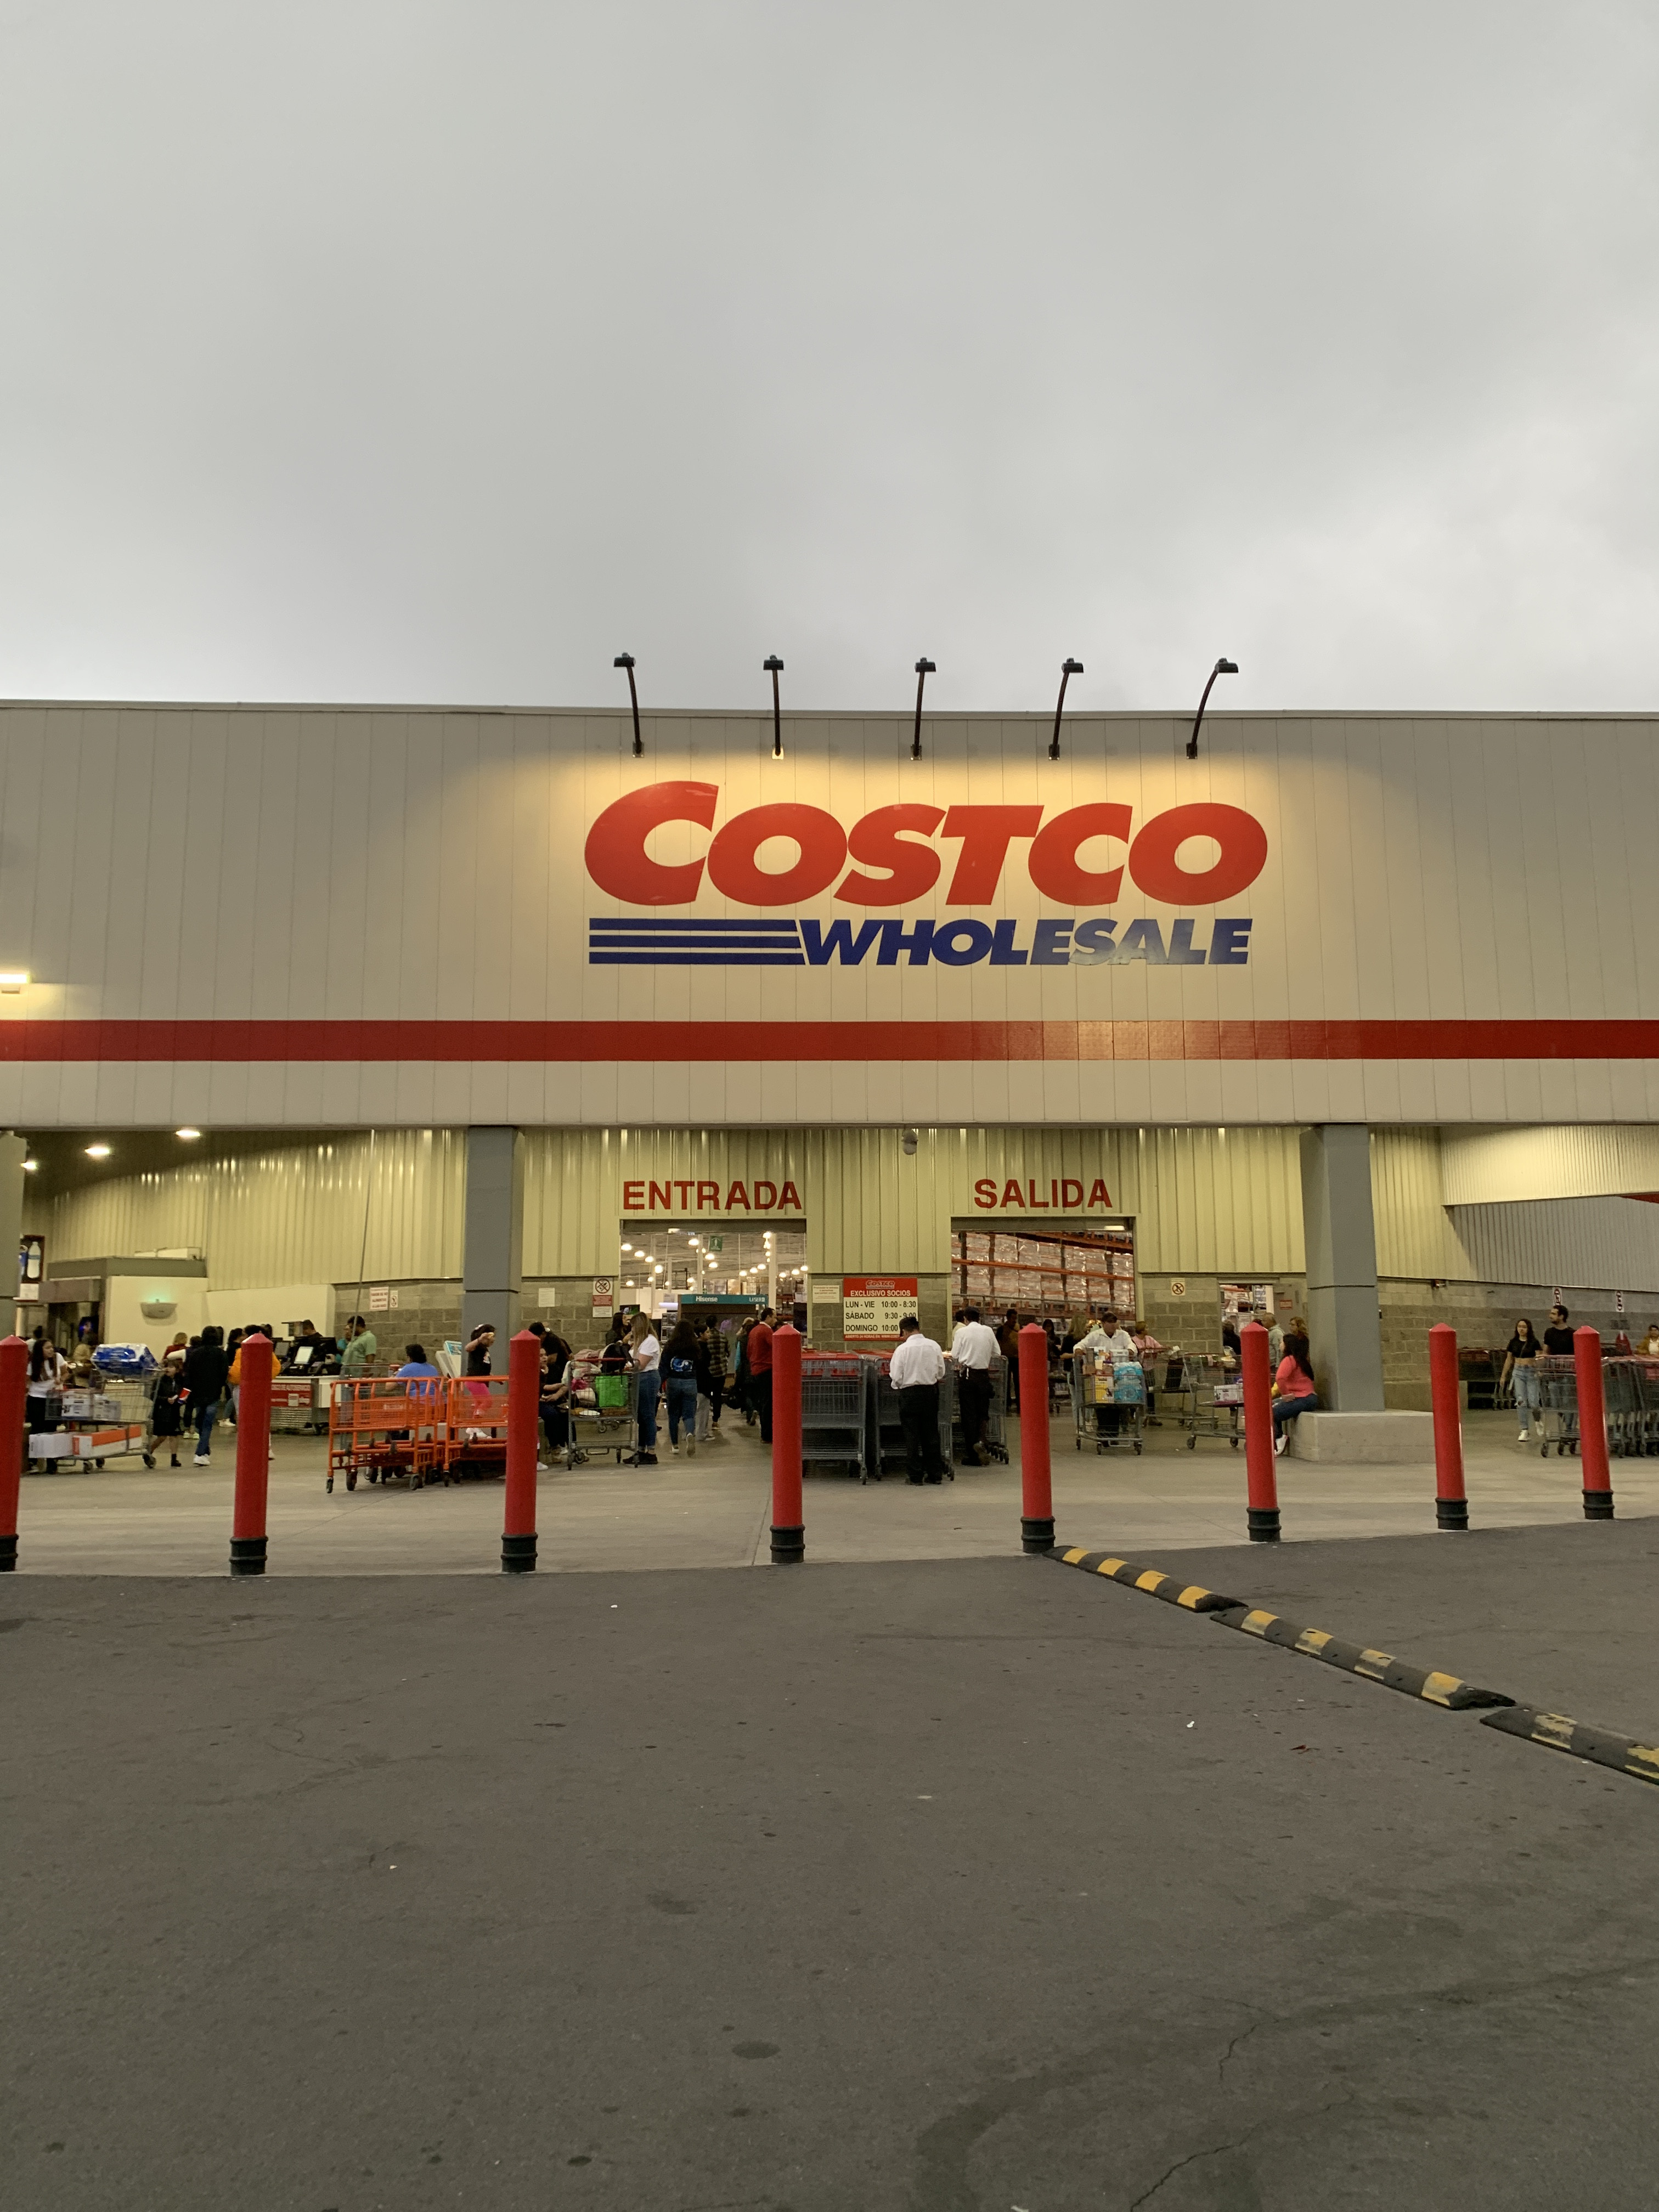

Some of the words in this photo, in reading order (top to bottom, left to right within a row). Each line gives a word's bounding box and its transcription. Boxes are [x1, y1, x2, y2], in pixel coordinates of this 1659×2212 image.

[585, 781, 1267, 906] COSTCO
[799, 919, 1252, 965] WHOLESALE
[623, 1181, 802, 1210] ENTRADA
[974, 1179, 1113, 1209] SALIDA
[845, 1311, 874, 1319] SÁBADO
